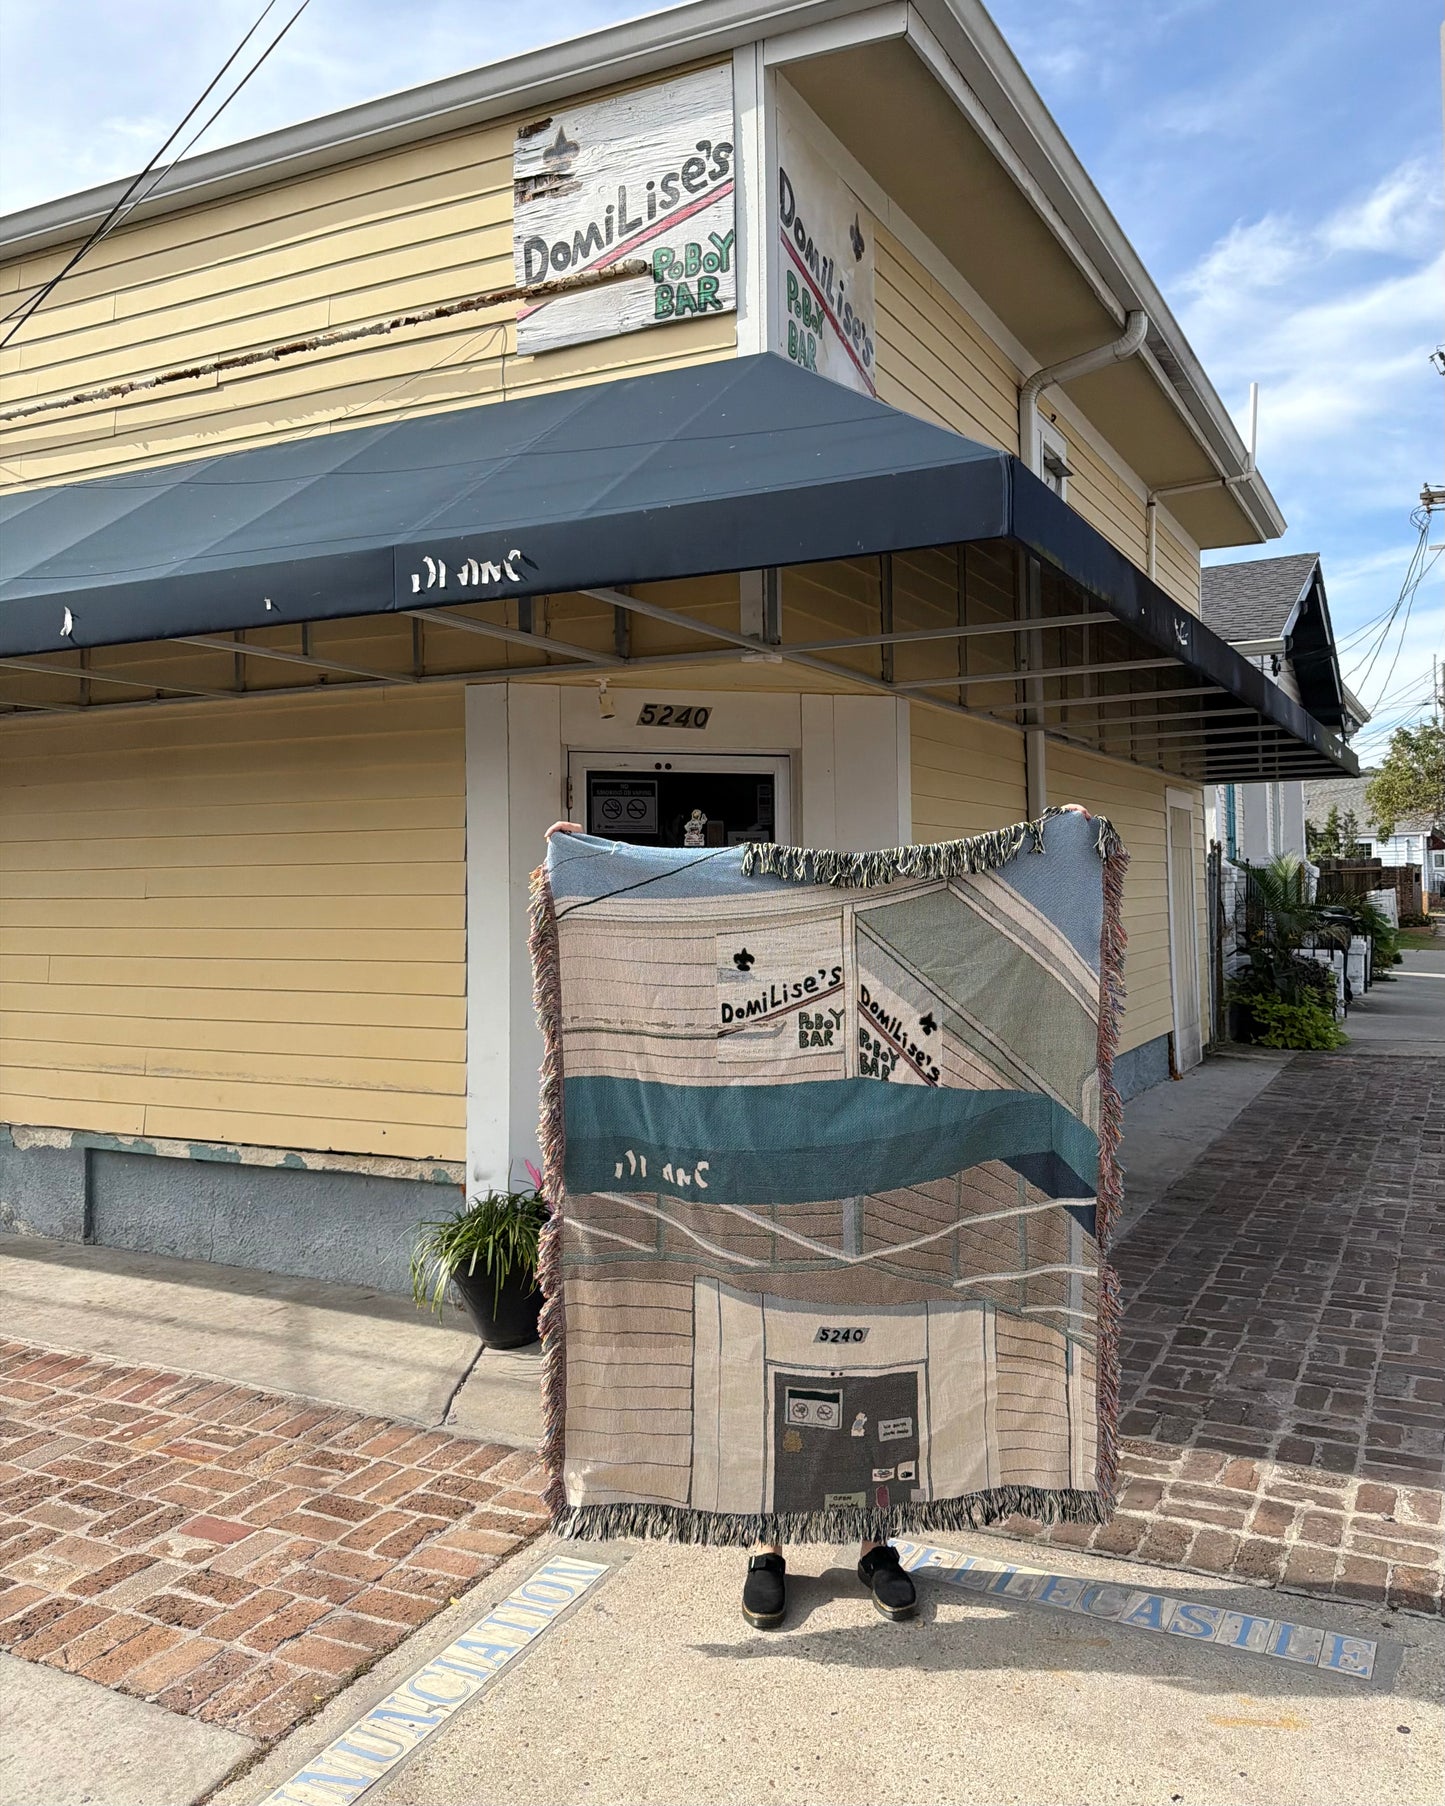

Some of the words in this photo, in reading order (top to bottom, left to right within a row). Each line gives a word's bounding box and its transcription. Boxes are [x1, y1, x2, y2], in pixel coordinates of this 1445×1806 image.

[654, 276, 724, 319] BAR
[788, 319, 818, 373] BAR
[640, 704, 710, 728] 5240
[799, 1030, 834, 1049] BAR
[859, 1052, 890, 1081] BAR
[819, 1328, 863, 1343] 5240
[272, 1556, 604, 1806] NUNCIATION
